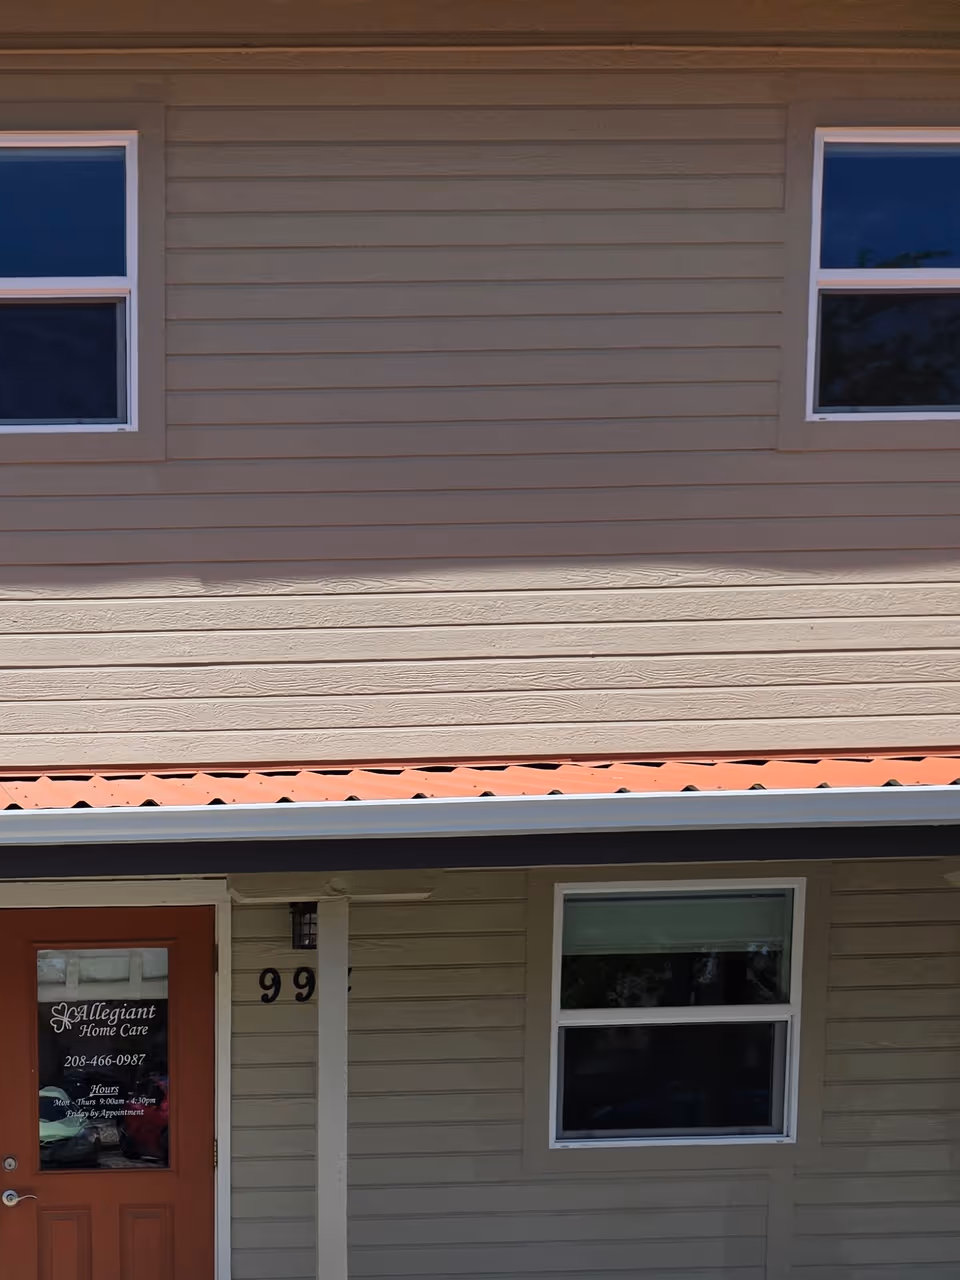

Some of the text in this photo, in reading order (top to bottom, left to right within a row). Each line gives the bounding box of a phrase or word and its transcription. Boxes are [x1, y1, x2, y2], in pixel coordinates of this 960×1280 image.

[258, 966, 352, 1004] 99
[76, 1002, 156, 1025] Allegiant
[78, 1023, 149, 1037] Home Care
[64, 1053, 146, 1067] 208-466-0987
[89, 1083, 120, 1096] Hours
[53, 1098, 70, 1107] Mon
[76, 1097, 96, 1106] Thurs
[99, 1097, 125, 1106] 9:00am
[130, 1096, 156, 1106] 4:30pm
[65, 1108, 144, 1119] Friday by Appointment
